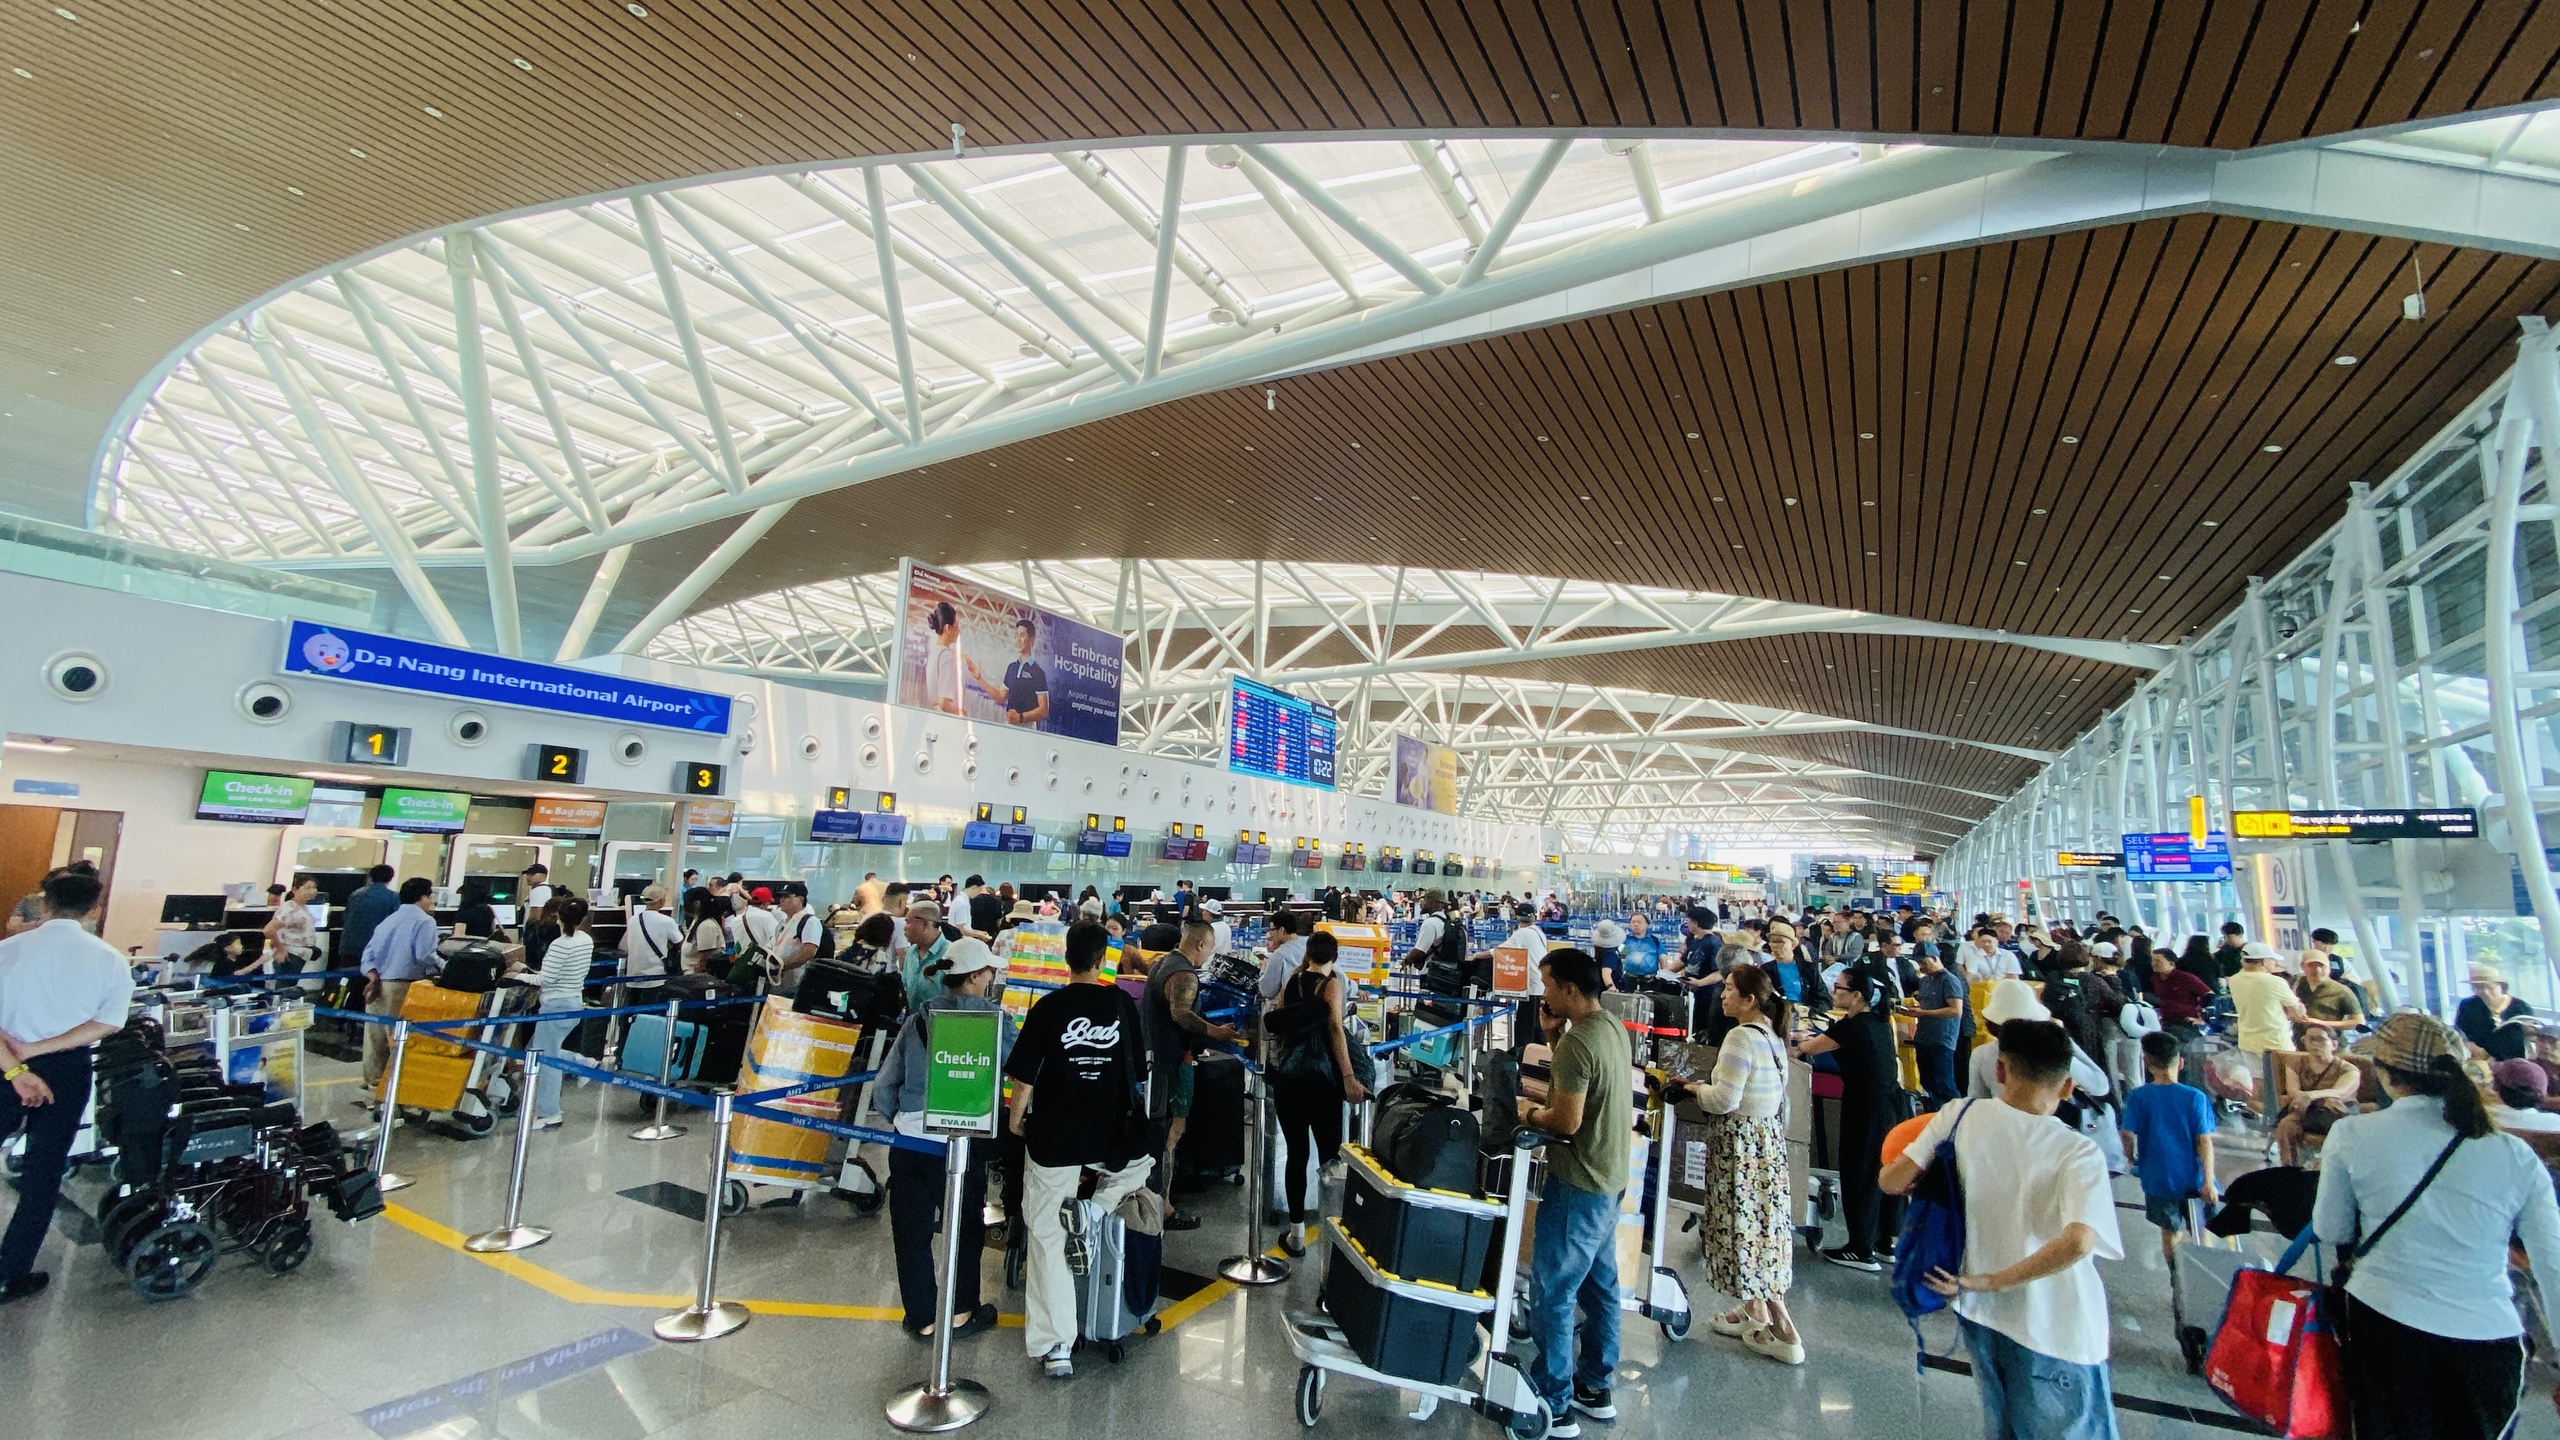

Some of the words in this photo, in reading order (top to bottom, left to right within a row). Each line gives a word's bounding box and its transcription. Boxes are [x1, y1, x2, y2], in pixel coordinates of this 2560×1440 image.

[1071, 642, 1119, 669] Embrace
[1054, 654, 1119, 688] Hospitality
[355, 649, 392, 668] Da
[397, 655, 466, 682] Nang
[471, 668, 618, 703] International
[622, 692, 692, 716] Airport
[1067, 689, 1088, 701] Airport
[1071, 701, 1094, 711] anytime
[1094, 707, 1104, 715] you
[1104, 709, 1117, 718] need
[368, 733, 384, 755] 1
[551, 755, 568, 775] 2
[1313, 758, 1333, 779] 10:22
[697, 769, 711, 788] 3
[224, 781, 293, 796] Check-in
[398, 796, 454, 809] Check-in
[835, 790, 845, 805] 5
[882, 795, 892, 809] 6
[554, 806, 574, 818] Bag
[576, 808, 600, 819] drop
[980, 806, 989, 818] 7
[1015, 809, 1023, 822] 8
[2290, 814, 2310, 824] Khu
[1116, 818, 1125, 830] 10
[1174, 825, 1181, 835] 11
[2125, 836, 2151, 845] SELF
[1061, 1017, 1120, 1050] Bad
[935, 1050, 991, 1066] Check-in
[785, 1088, 802, 1097] AHT
[792, 1117, 807, 1126] AHT
[839, 1126, 872, 1139] International
